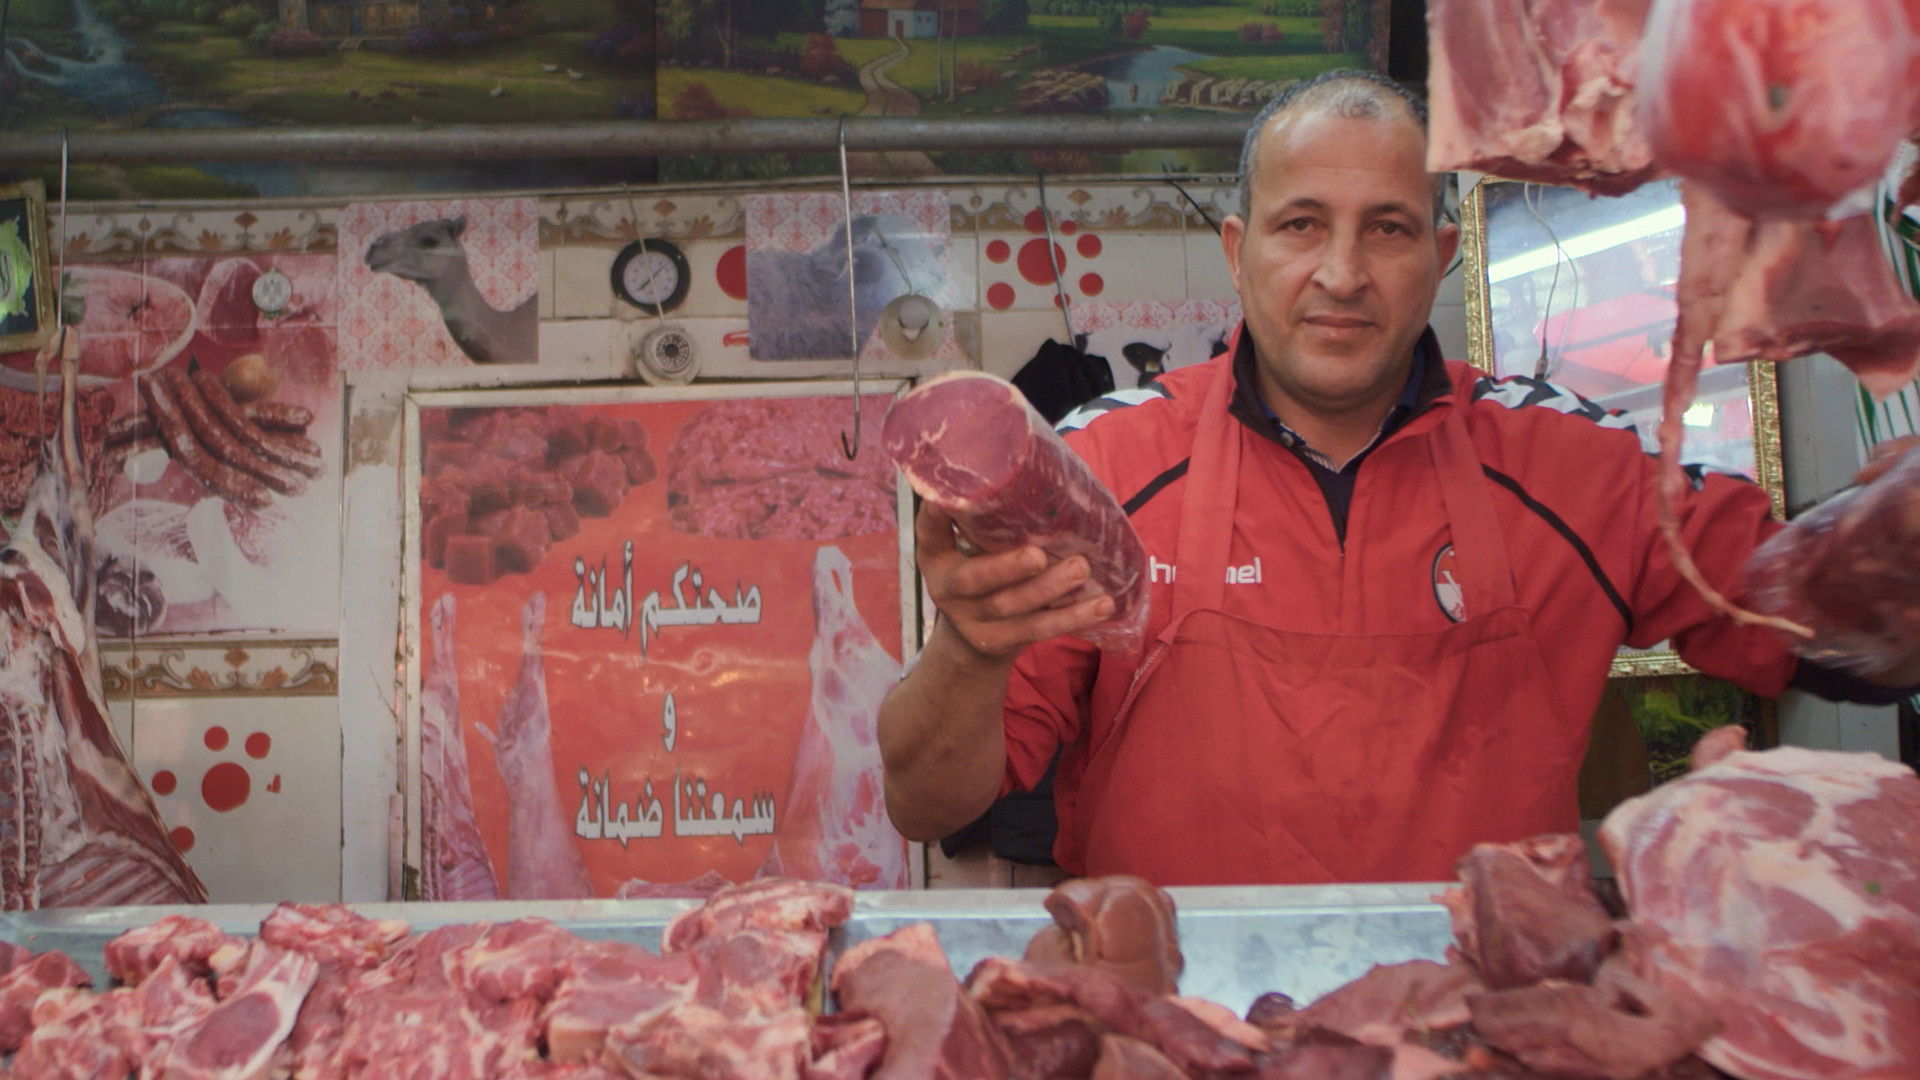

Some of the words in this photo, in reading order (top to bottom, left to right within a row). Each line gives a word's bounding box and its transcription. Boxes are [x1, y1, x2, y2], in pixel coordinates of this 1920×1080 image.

[571, 540, 634, 637] أمانة
[641, 560, 762, 656] صحتكم
[1149, 555, 1262, 584] hel
[661, 692, 677, 752] و
[575, 767, 664, 849] ضمانة
[673, 765, 775, 845] سمعتنا
